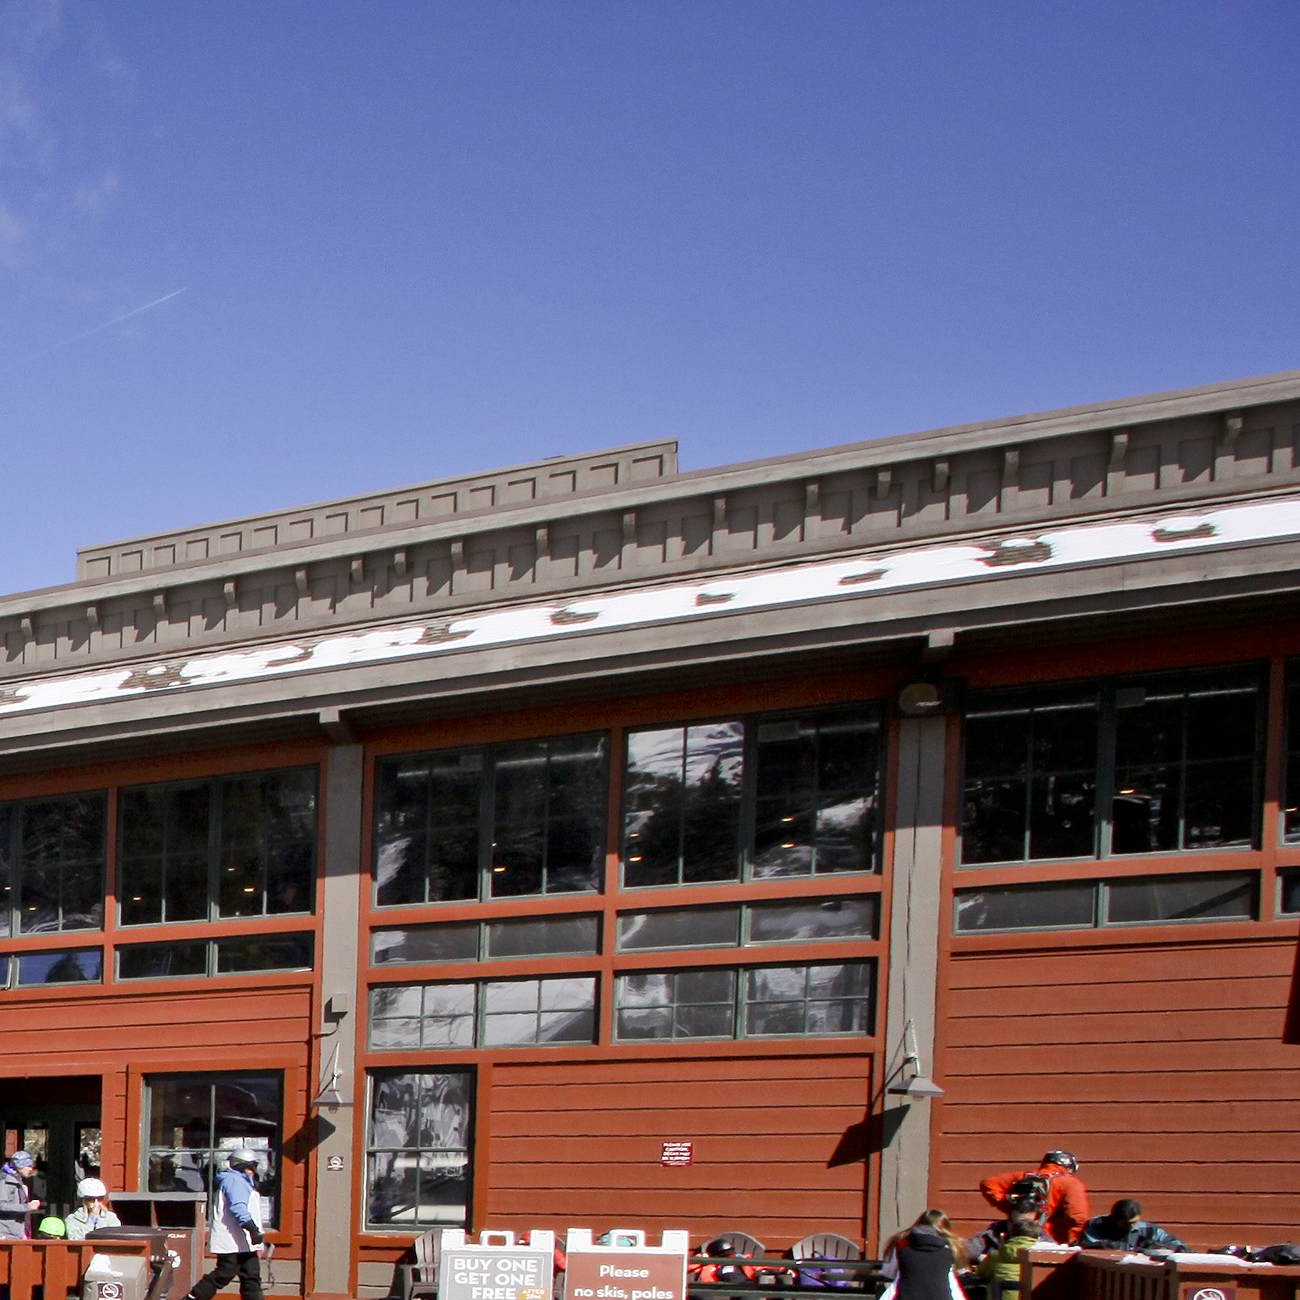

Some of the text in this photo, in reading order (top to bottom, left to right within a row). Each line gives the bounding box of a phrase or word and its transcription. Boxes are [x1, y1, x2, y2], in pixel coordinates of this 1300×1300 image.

[453, 1258, 538, 1273] BUY ONE
[599, 1264, 649, 1278] Please
[454, 1272, 536, 1287] GET ONE
[471, 1287, 517, 1300] FREE
[574, 1285, 674, 1300] no skis, poles
